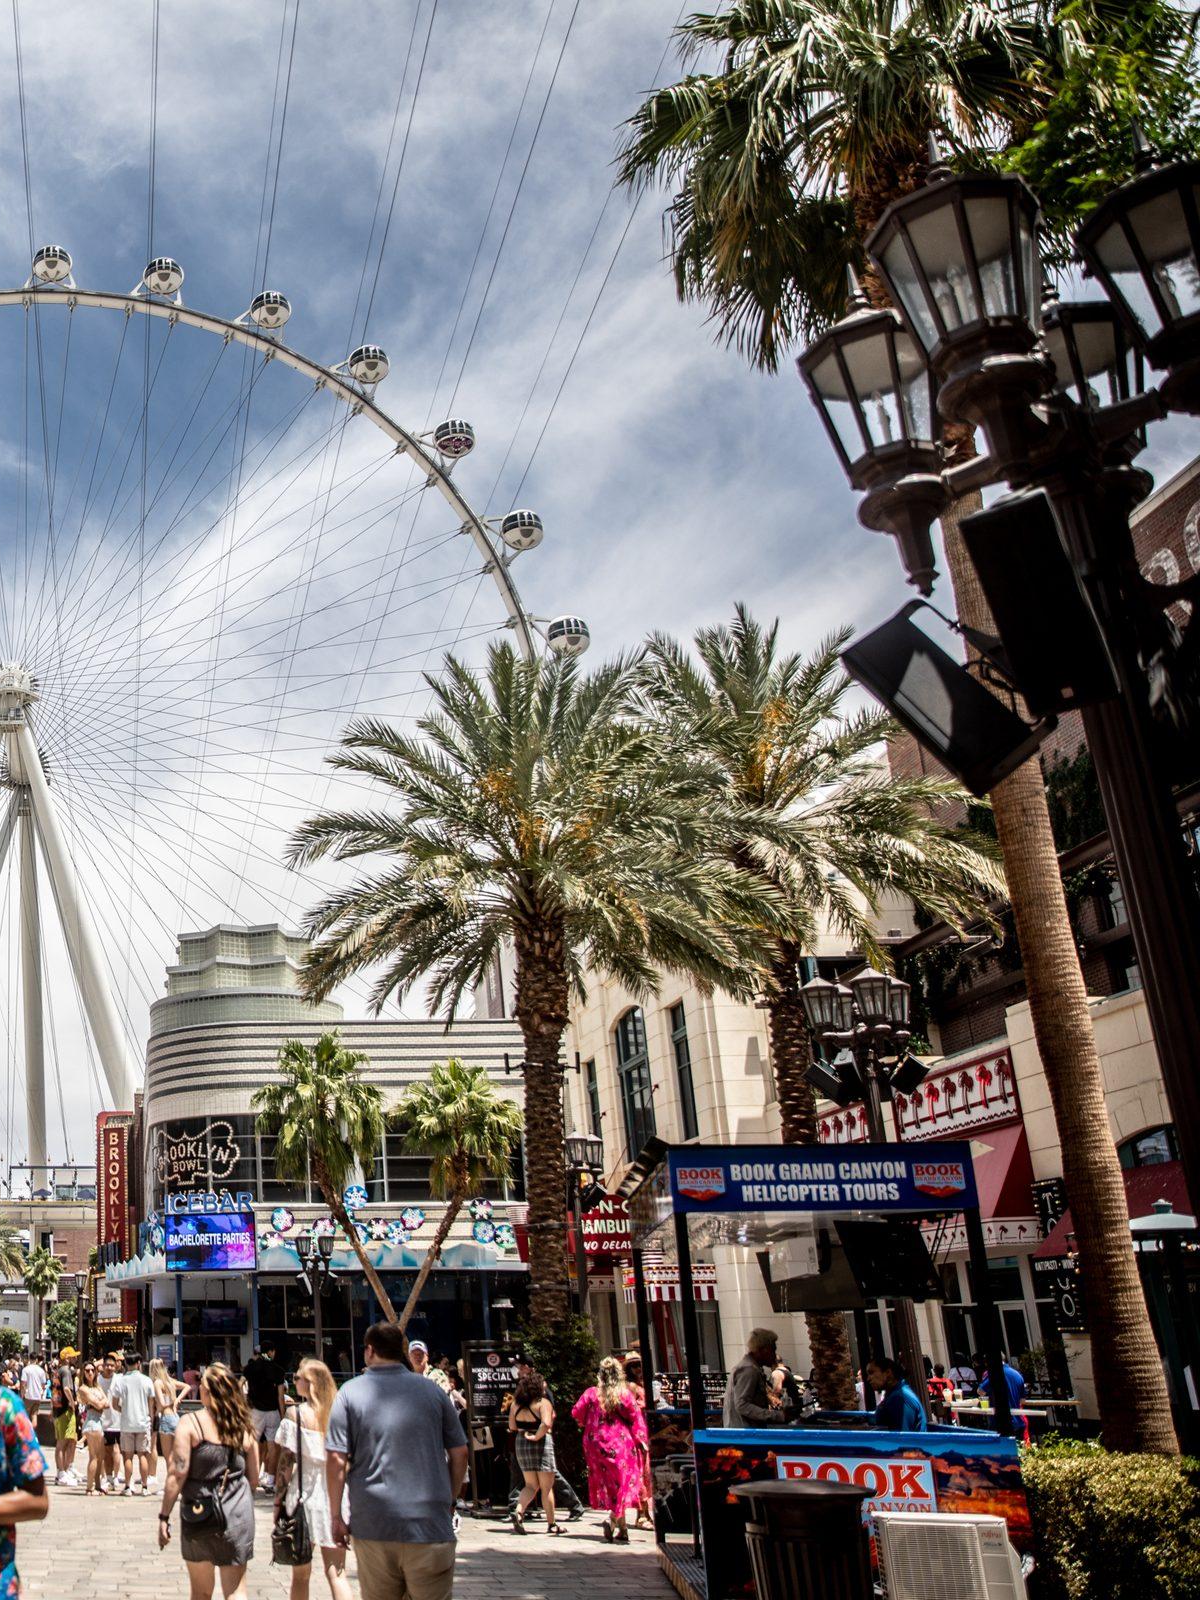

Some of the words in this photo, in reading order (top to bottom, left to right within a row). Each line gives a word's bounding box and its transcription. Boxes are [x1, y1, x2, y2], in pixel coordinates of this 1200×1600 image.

[172, 1159, 205, 1173] BOWL
[730, 1164, 776, 1181] BOOK
[778, 1163, 836, 1181] GRAND
[838, 1161, 907, 1179] CANYON
[914, 1164, 962, 1175] BOOK
[678, 1168, 722, 1179] BOOK
[741, 1184, 840, 1202] HELICOPTER
[842, 1182, 901, 1200] TOURS
[164, 1191, 253, 1214] ICEBAR
[169, 1233, 224, 1246] BACHELORETTE
[223, 1232, 251, 1244] PARTIES
[583, 1241, 599, 1250] NO
[477, 1372, 512, 1381] SPECIAL
[861, 1501, 931, 1513] ANYON
